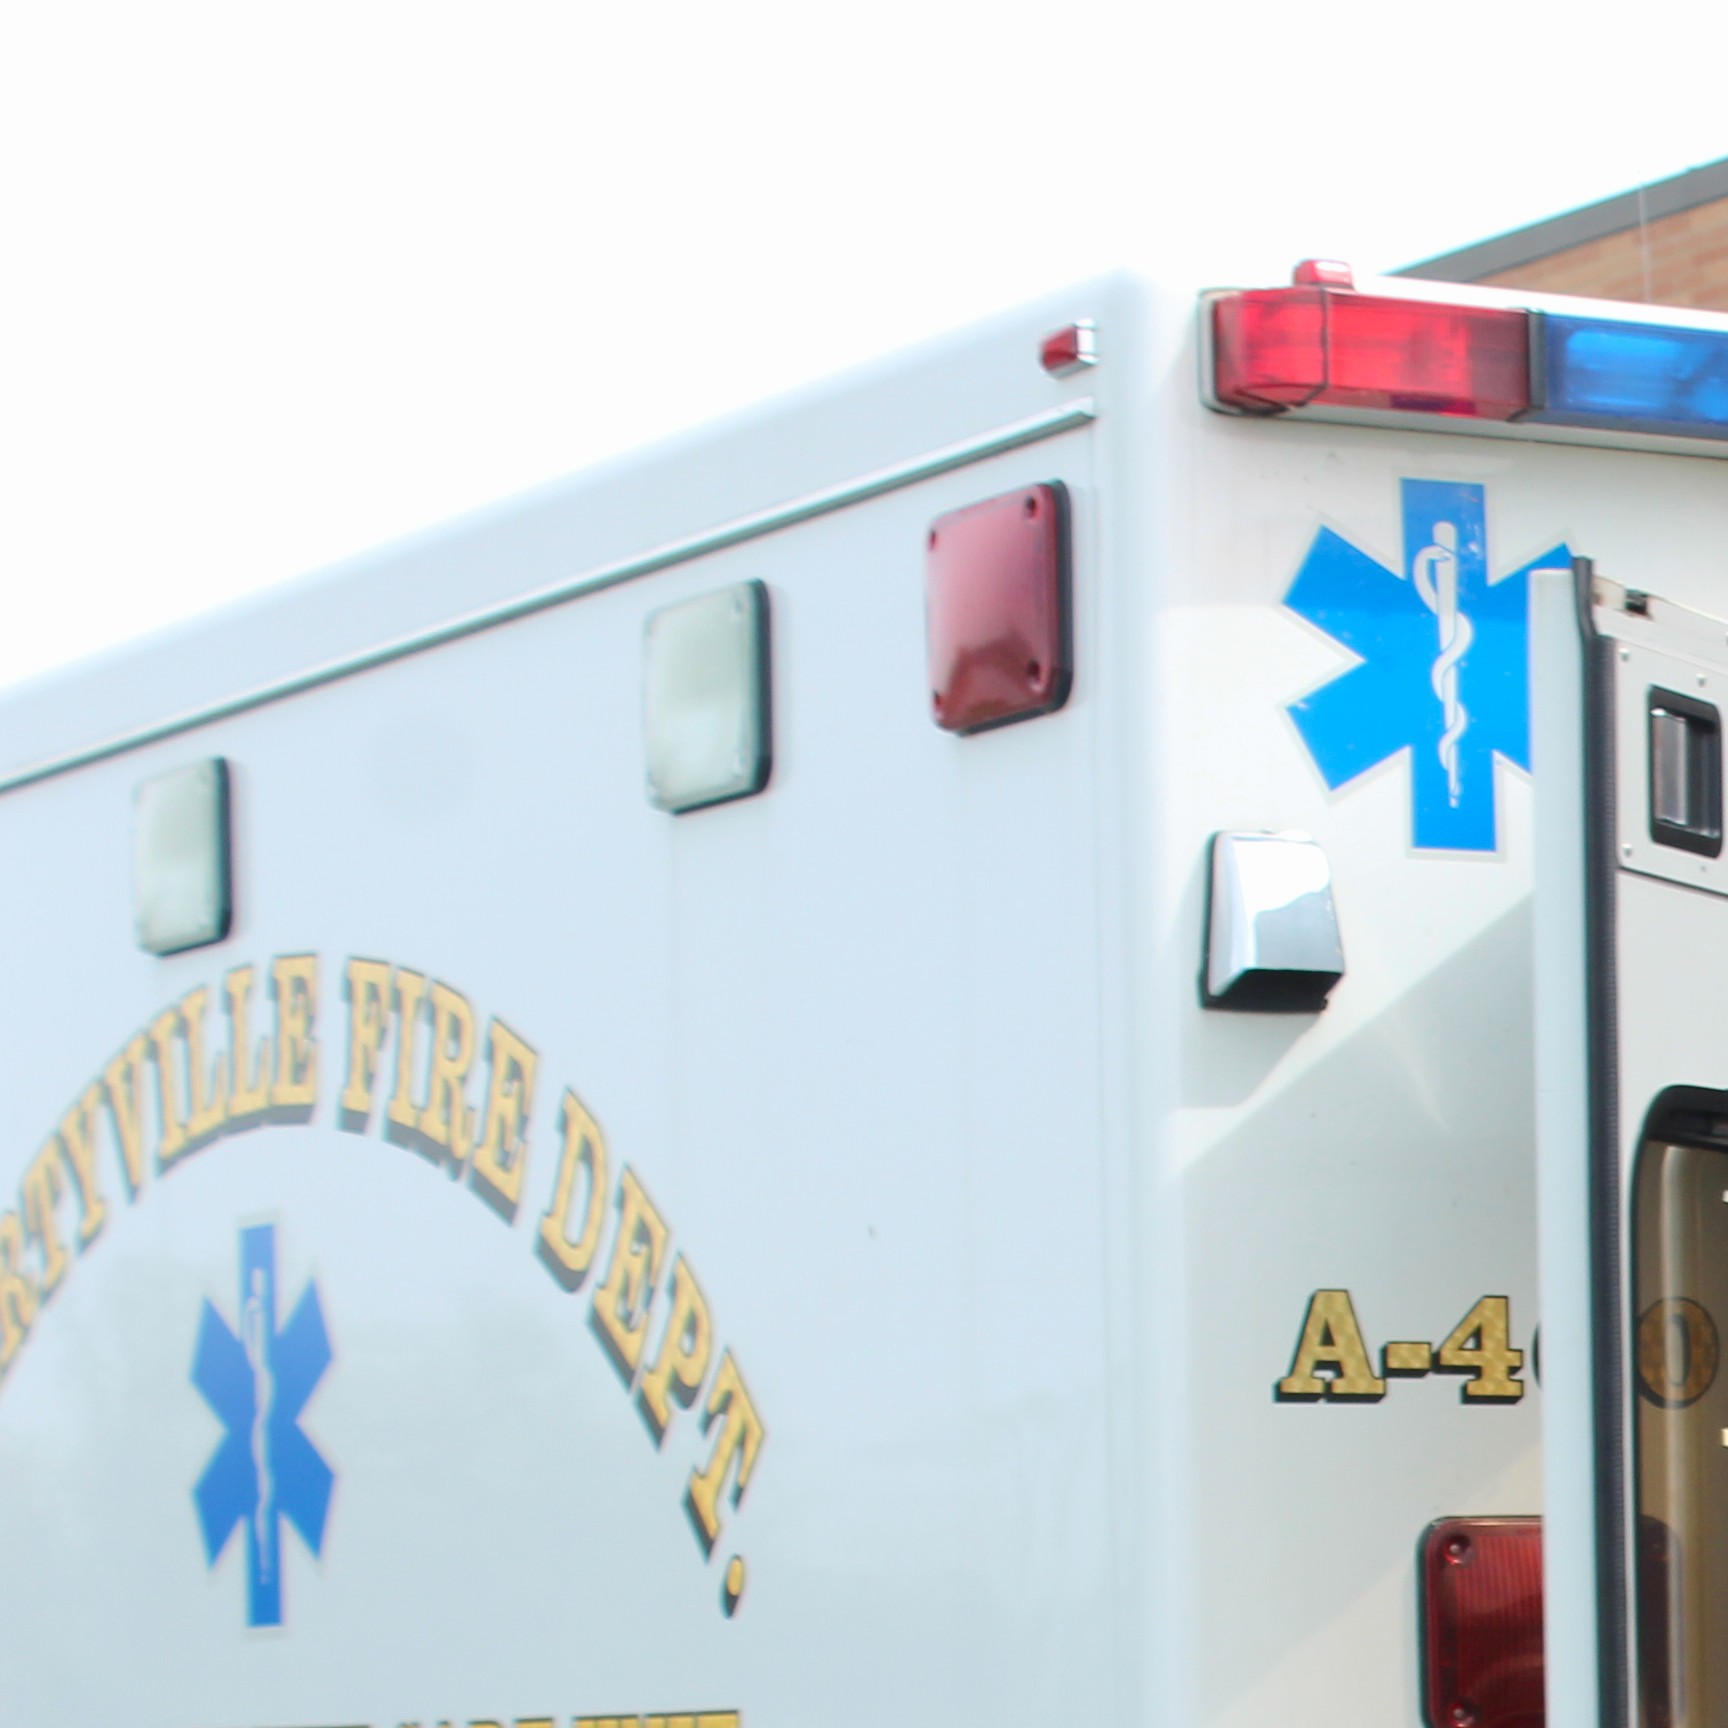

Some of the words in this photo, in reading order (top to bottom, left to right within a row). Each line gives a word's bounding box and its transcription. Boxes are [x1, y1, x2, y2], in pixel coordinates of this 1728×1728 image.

[337, 956, 539, 1226] FIRE
[533, 1086, 765, 1619] DEPT.
[1273, 1288, 1720, 1410] A-40
